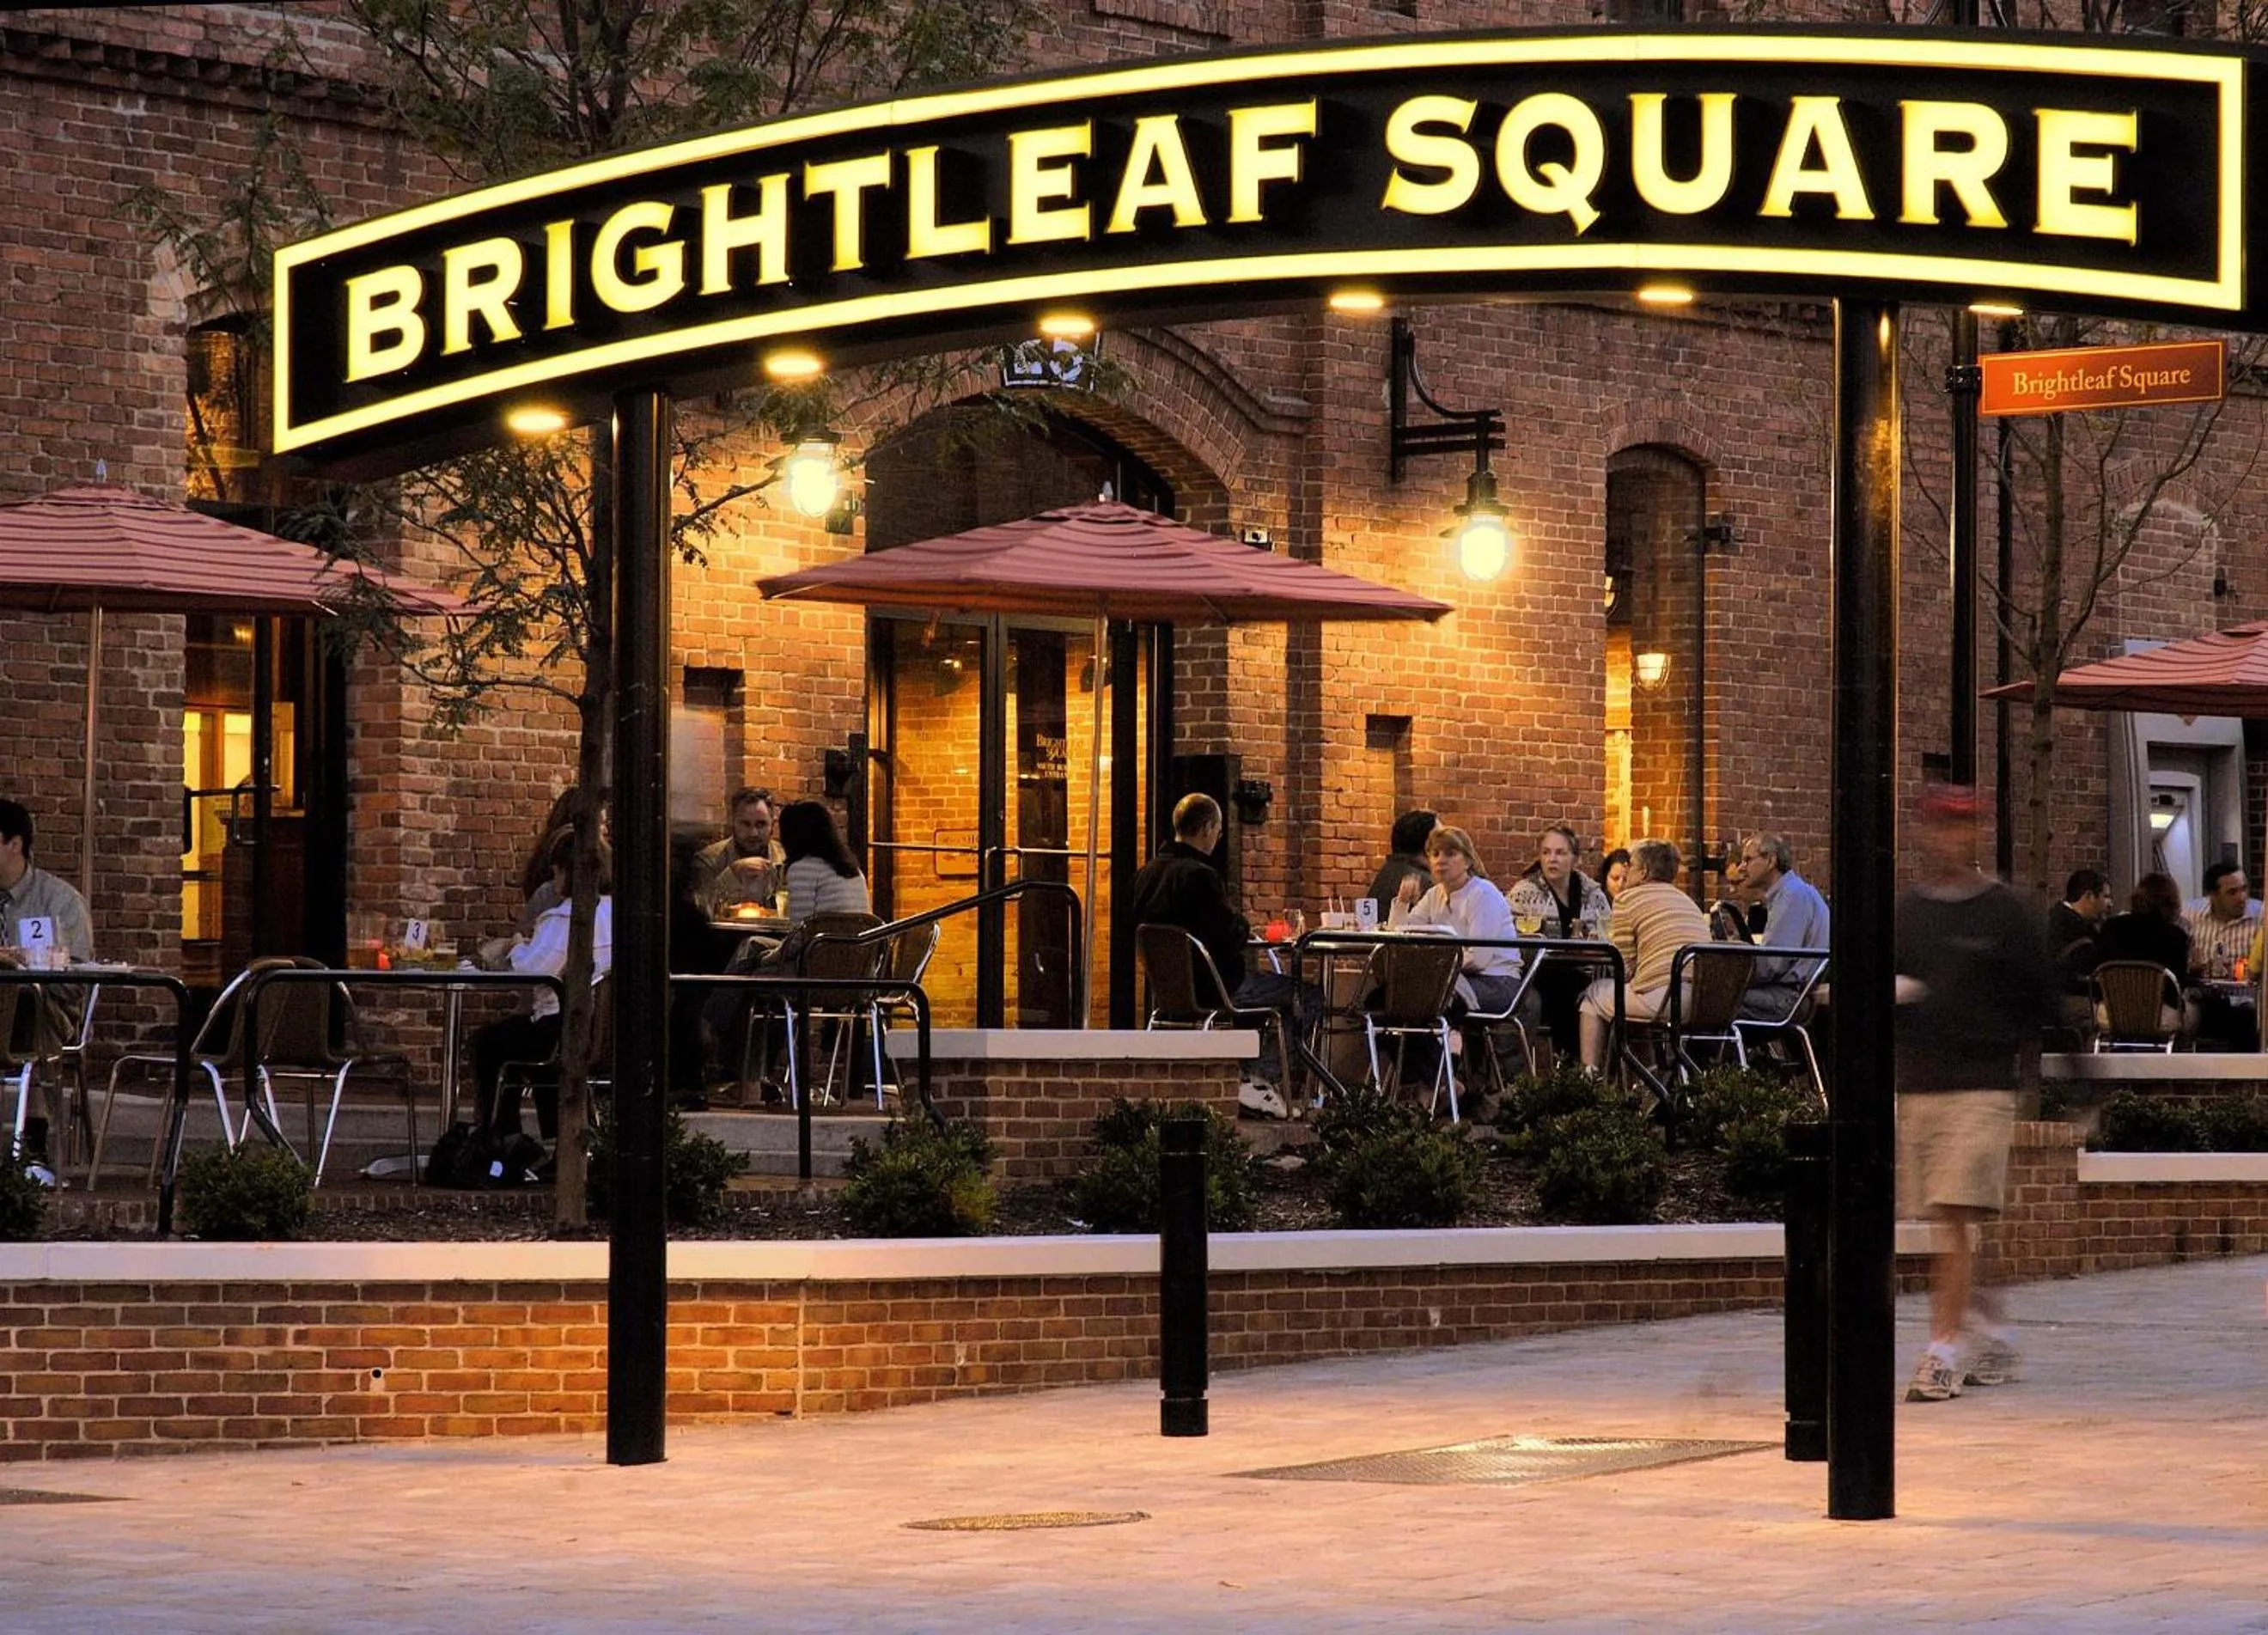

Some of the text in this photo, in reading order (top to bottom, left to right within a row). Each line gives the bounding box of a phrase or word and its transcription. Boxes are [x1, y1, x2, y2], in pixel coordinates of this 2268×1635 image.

[345, 91, 2141, 383] BRIGHTLEAF SQUARE
[2012, 364, 2192, 400] Brightleaf Square
[1363, 900, 1370, 916] 5
[31, 920, 43, 939] 2
[412, 922, 421, 941] 3
